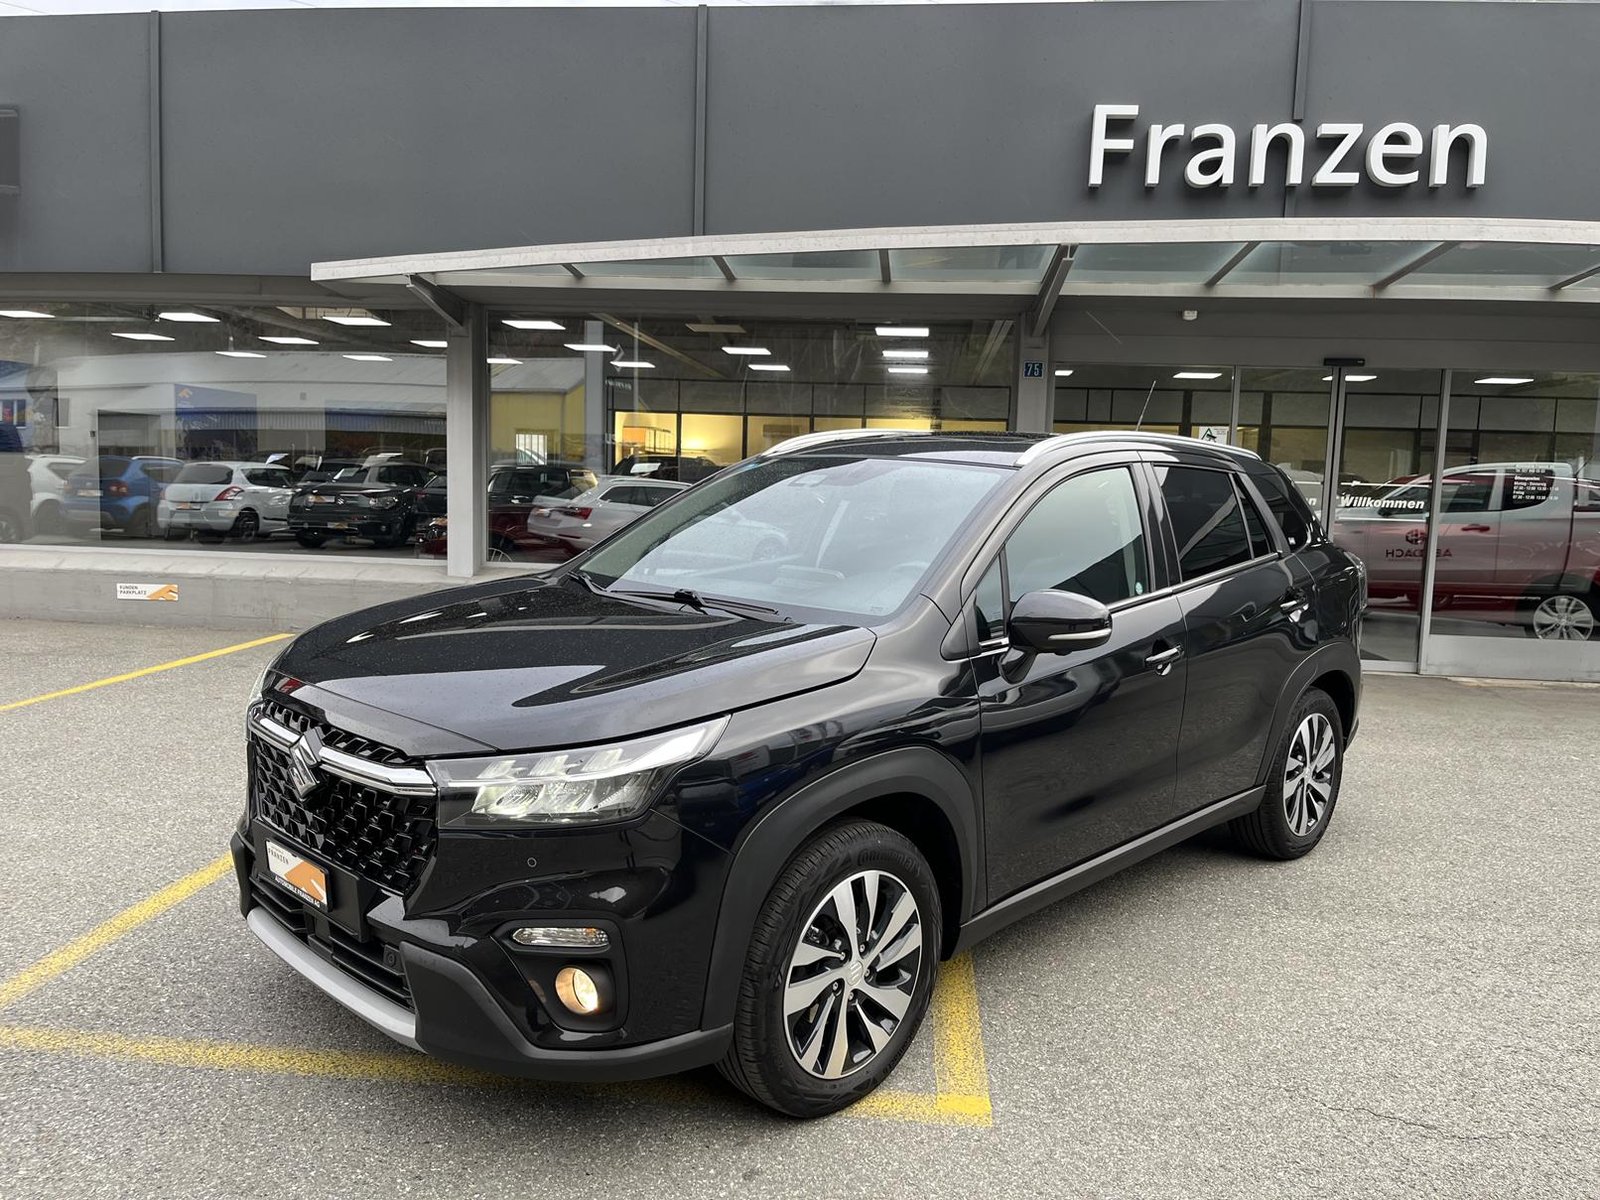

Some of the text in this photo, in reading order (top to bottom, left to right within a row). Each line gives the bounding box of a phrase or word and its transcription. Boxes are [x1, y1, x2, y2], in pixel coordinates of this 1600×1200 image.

[1088, 103, 1488, 188] Franzen
[1027, 363, 1040, 377] 75
[1339, 495, 1425, 510] Willkommen
